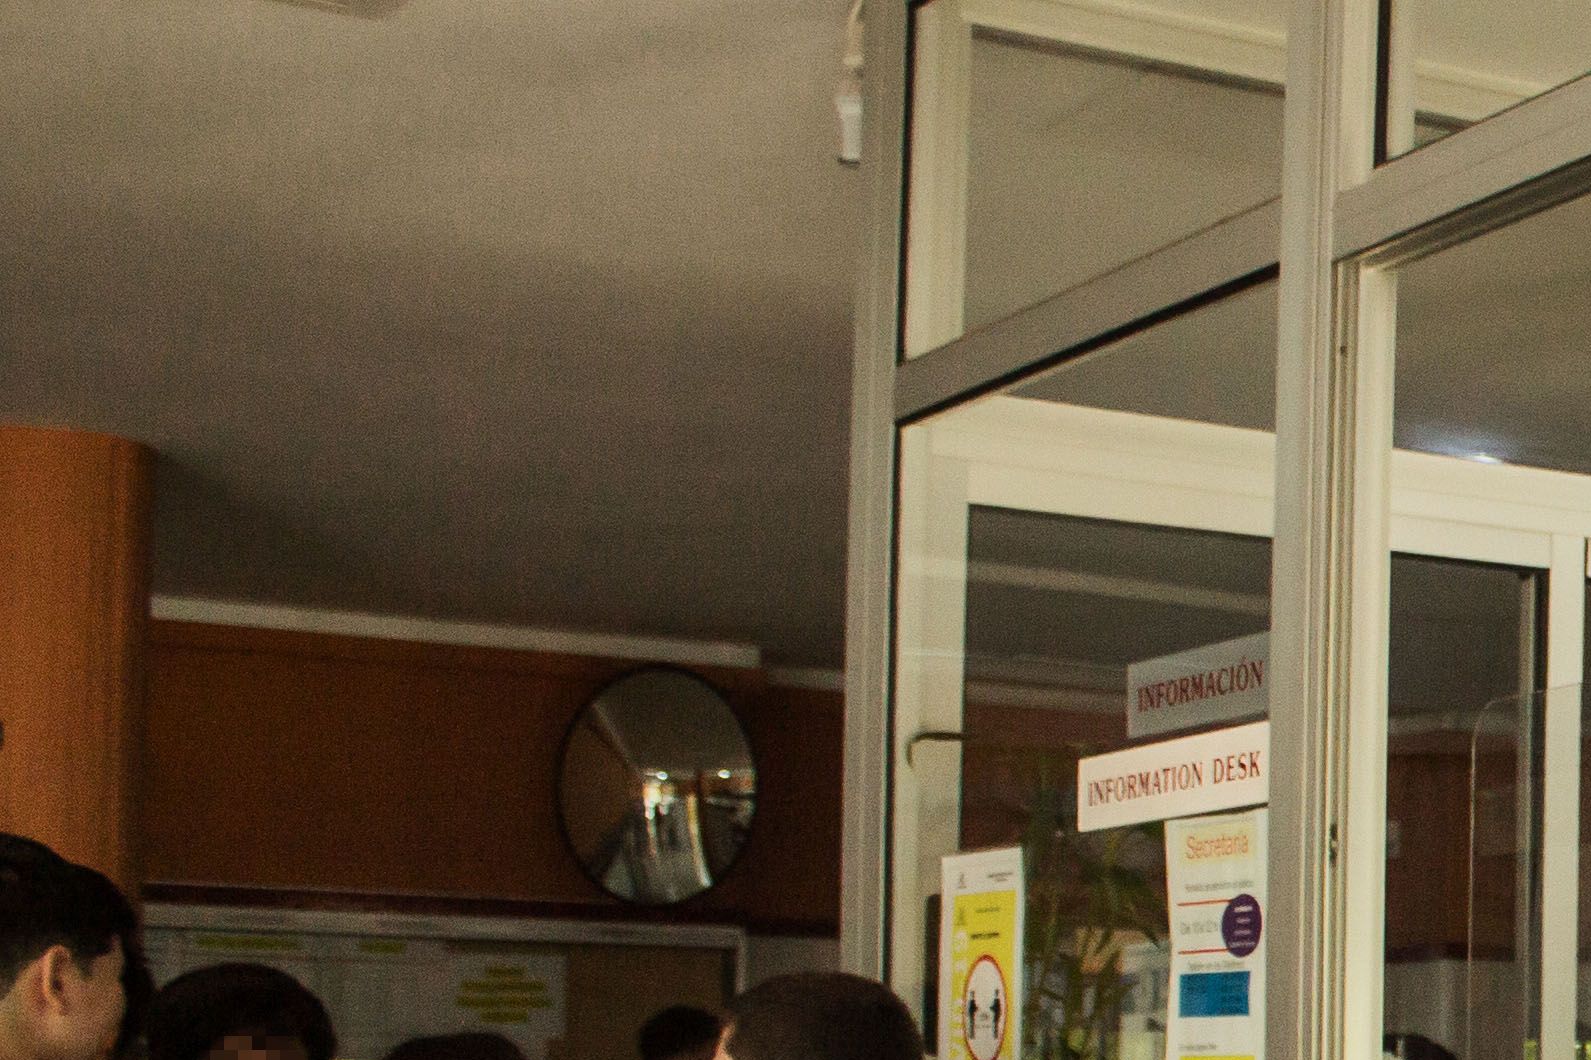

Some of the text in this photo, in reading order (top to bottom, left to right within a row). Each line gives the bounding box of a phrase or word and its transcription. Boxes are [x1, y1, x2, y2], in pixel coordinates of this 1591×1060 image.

[1137, 656, 1265, 713] INFORMACIÓN
[1088, 750, 1262, 807] INFORMATION DESK
